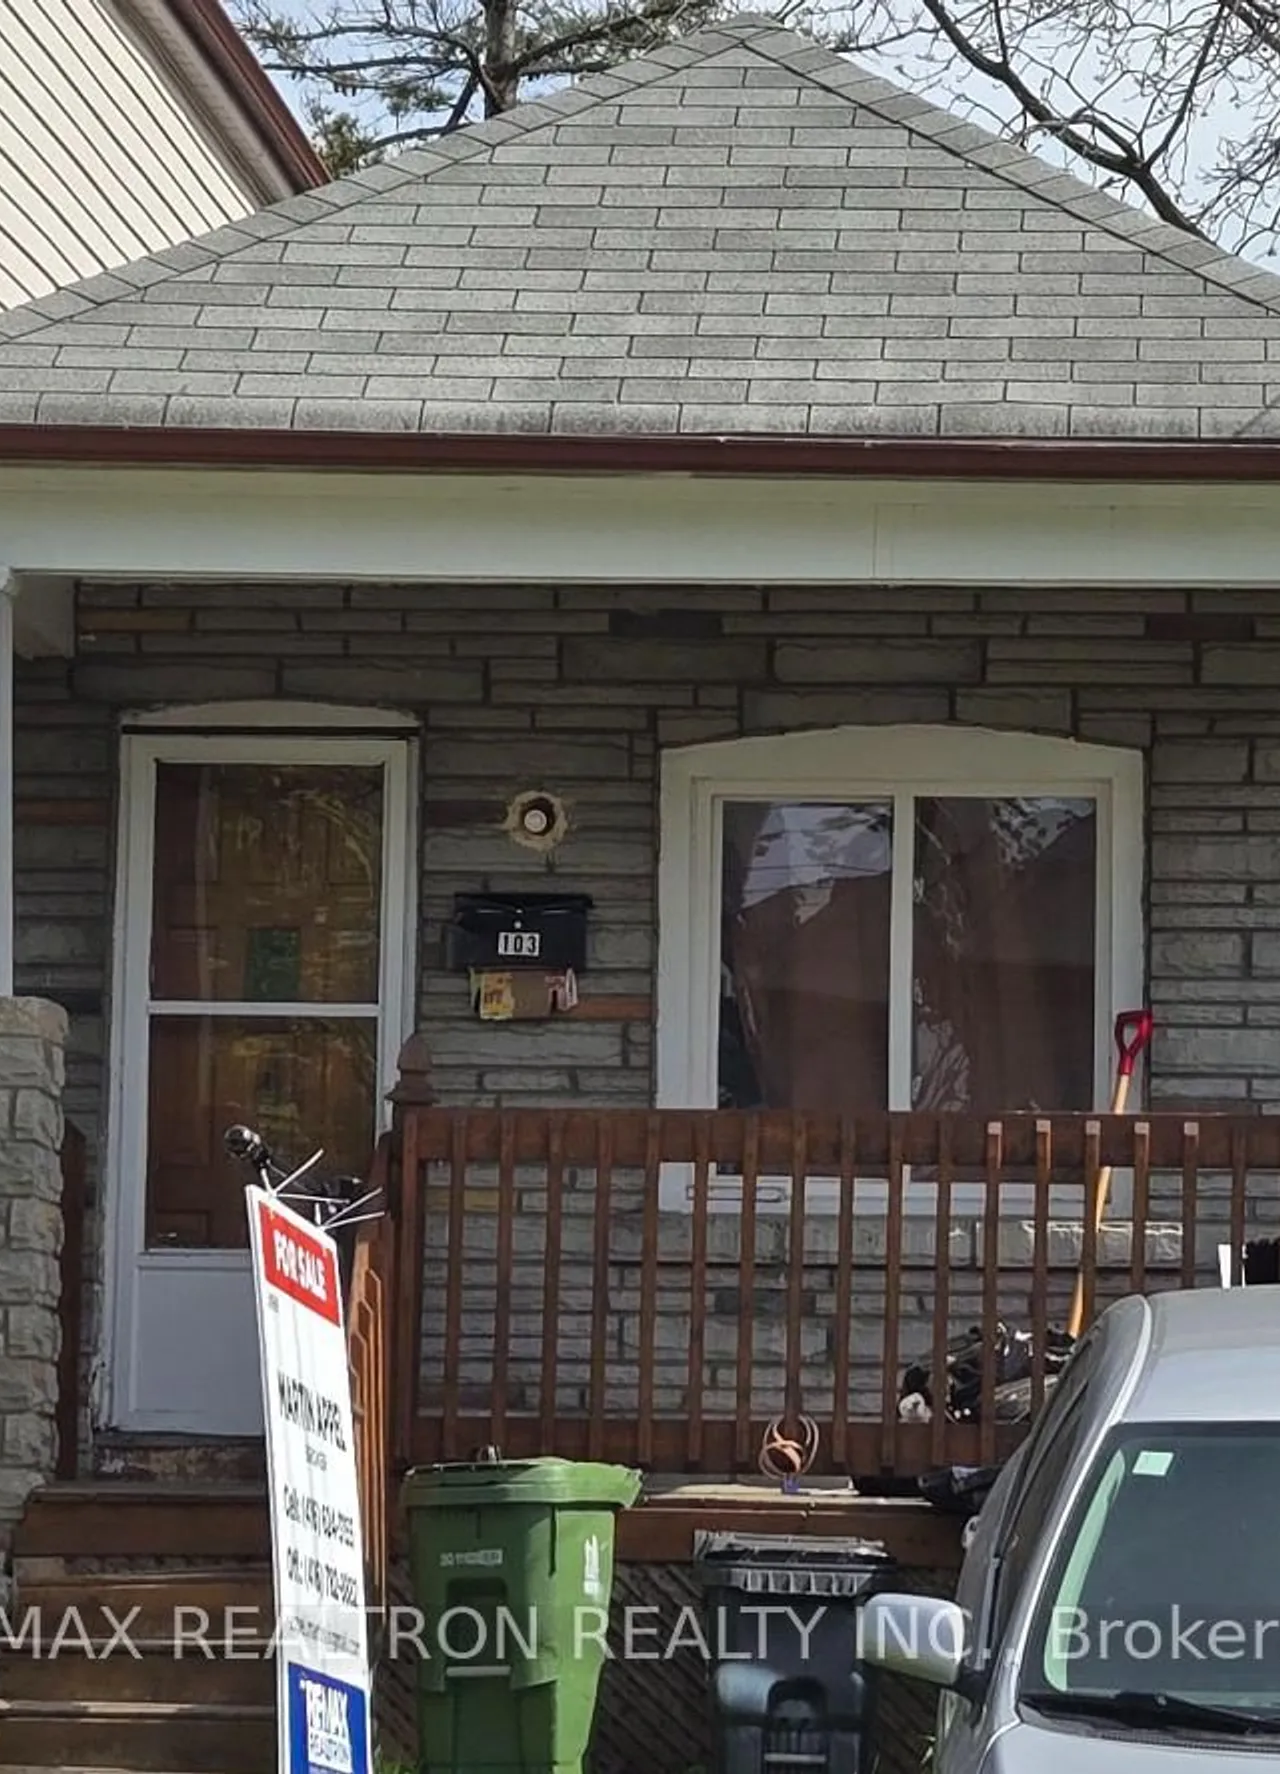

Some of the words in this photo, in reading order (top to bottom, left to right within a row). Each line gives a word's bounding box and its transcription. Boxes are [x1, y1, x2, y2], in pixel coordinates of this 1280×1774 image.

[503, 934, 537, 953] 103
[273, 1229, 299, 1284] FOR
[298, 1245, 328, 1303] SALE
[277, 1371, 315, 1433] MARTIN
